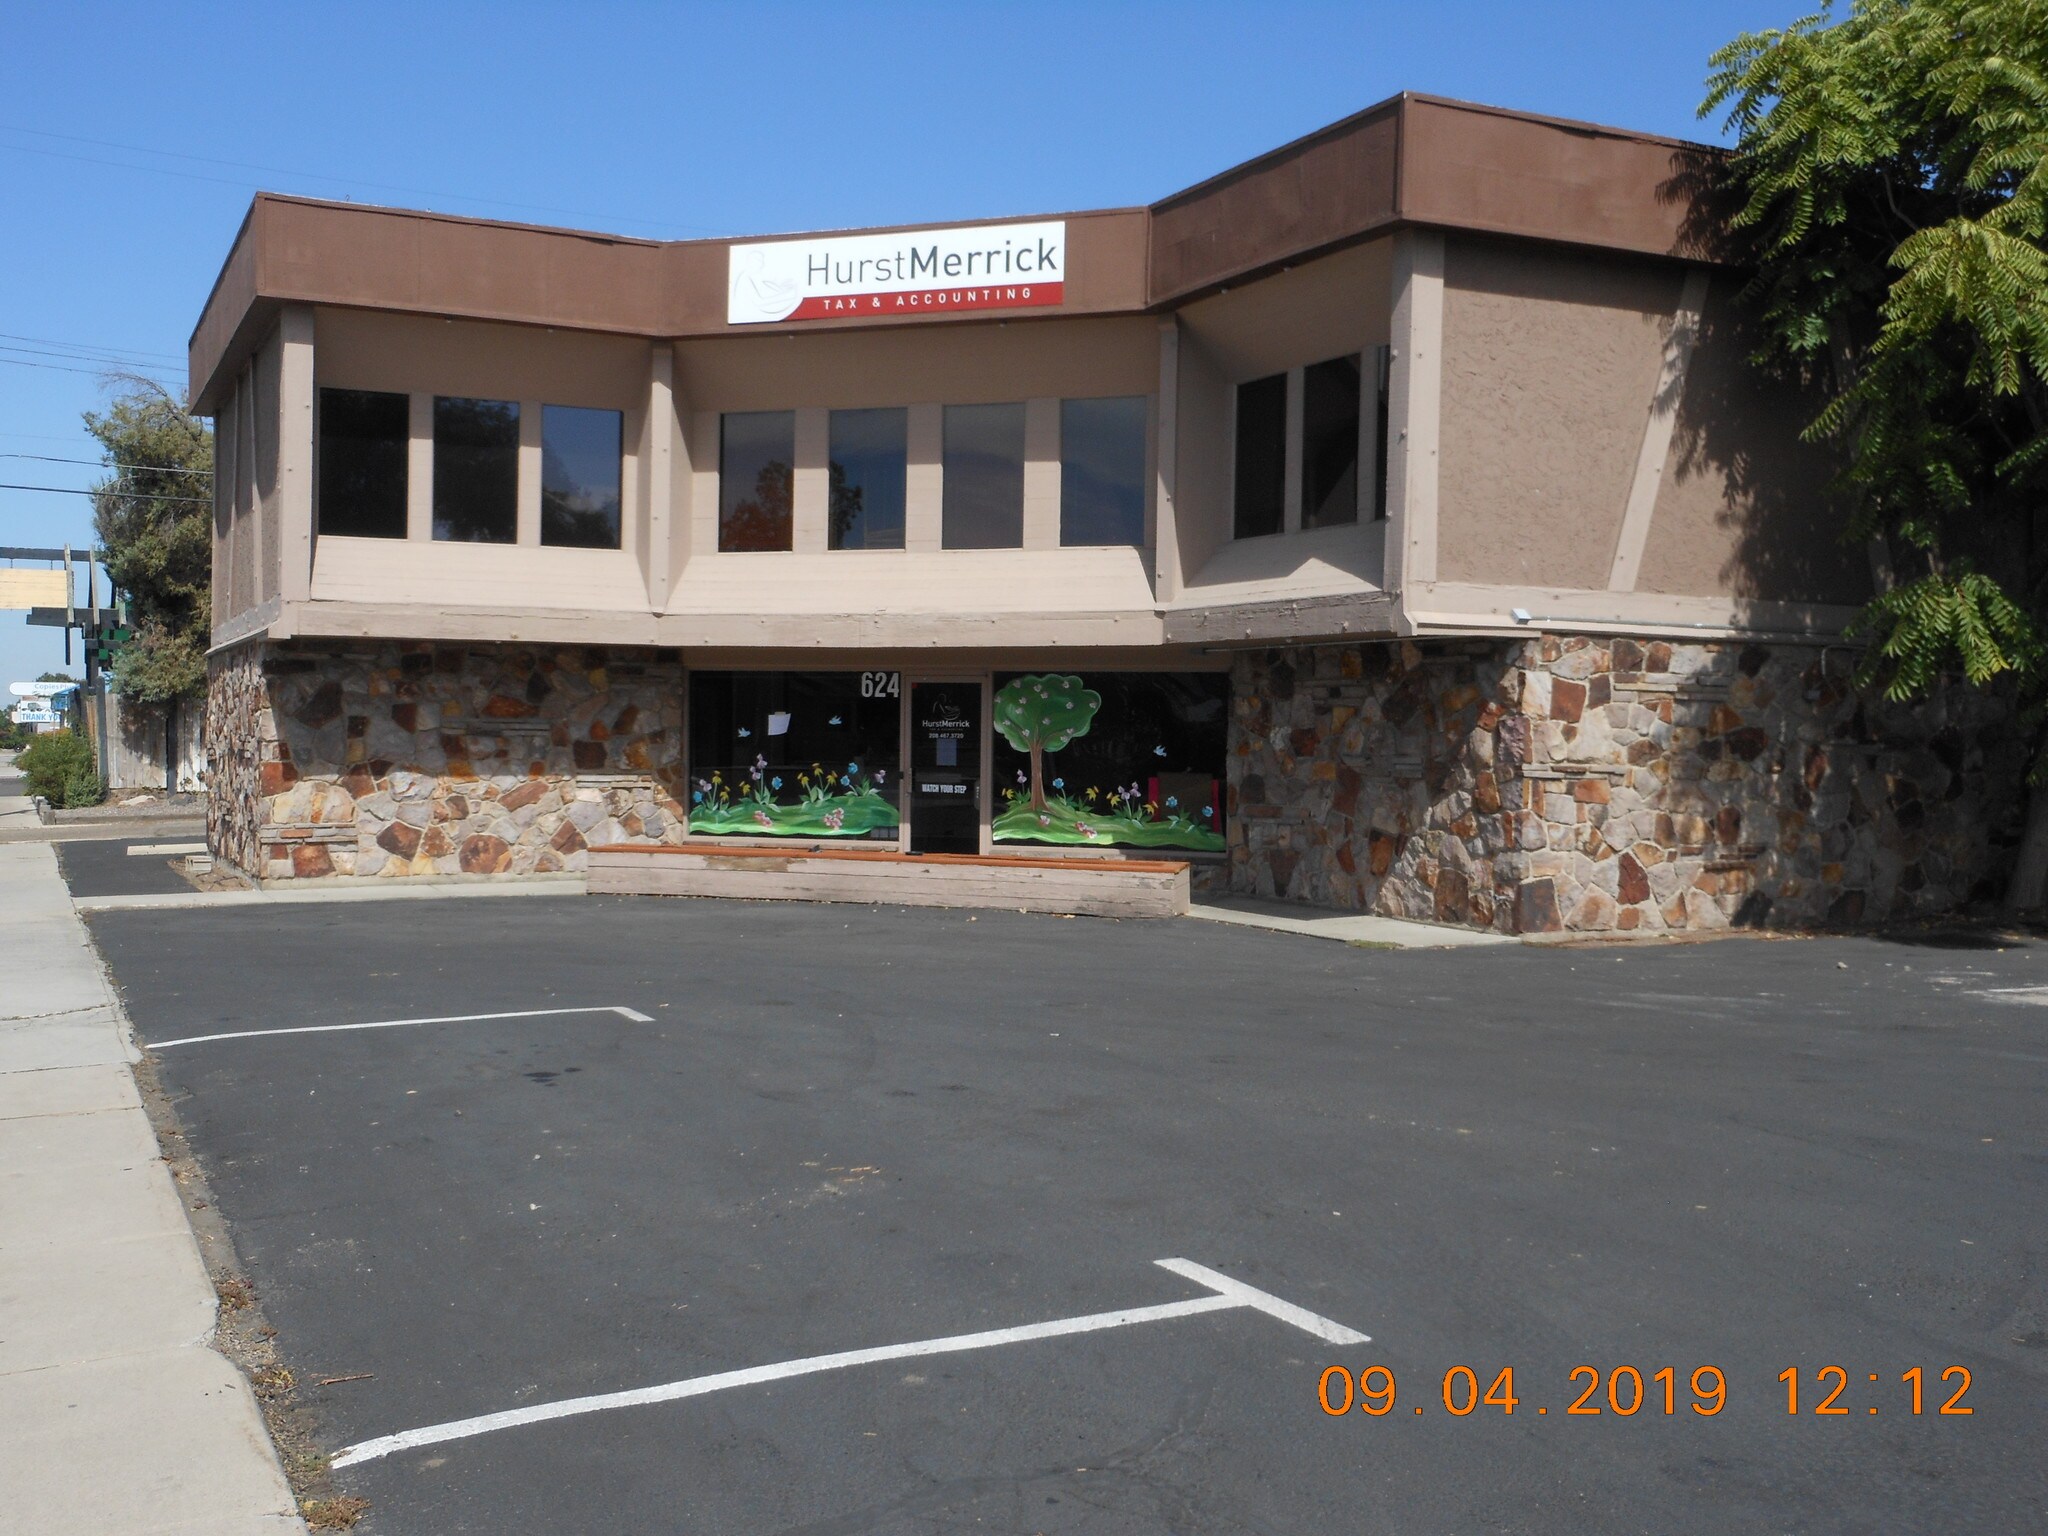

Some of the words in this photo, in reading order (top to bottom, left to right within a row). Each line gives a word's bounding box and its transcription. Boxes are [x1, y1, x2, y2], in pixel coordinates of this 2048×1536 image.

[807, 238, 1058, 286] HurstMerrick
[824, 299, 857, 310] TAX
[872, 297, 881, 307] &
[896, 288, 1031, 306] ACCOUNTING
[861, 672, 899, 698] 624
[22, 713, 46, 721] THANK
[922, 720, 970, 728] HurstMerrick
[922, 784, 939, 792] WATCH
[940, 784, 953, 793] YOUR
[954, 785, 967, 793] STEP
